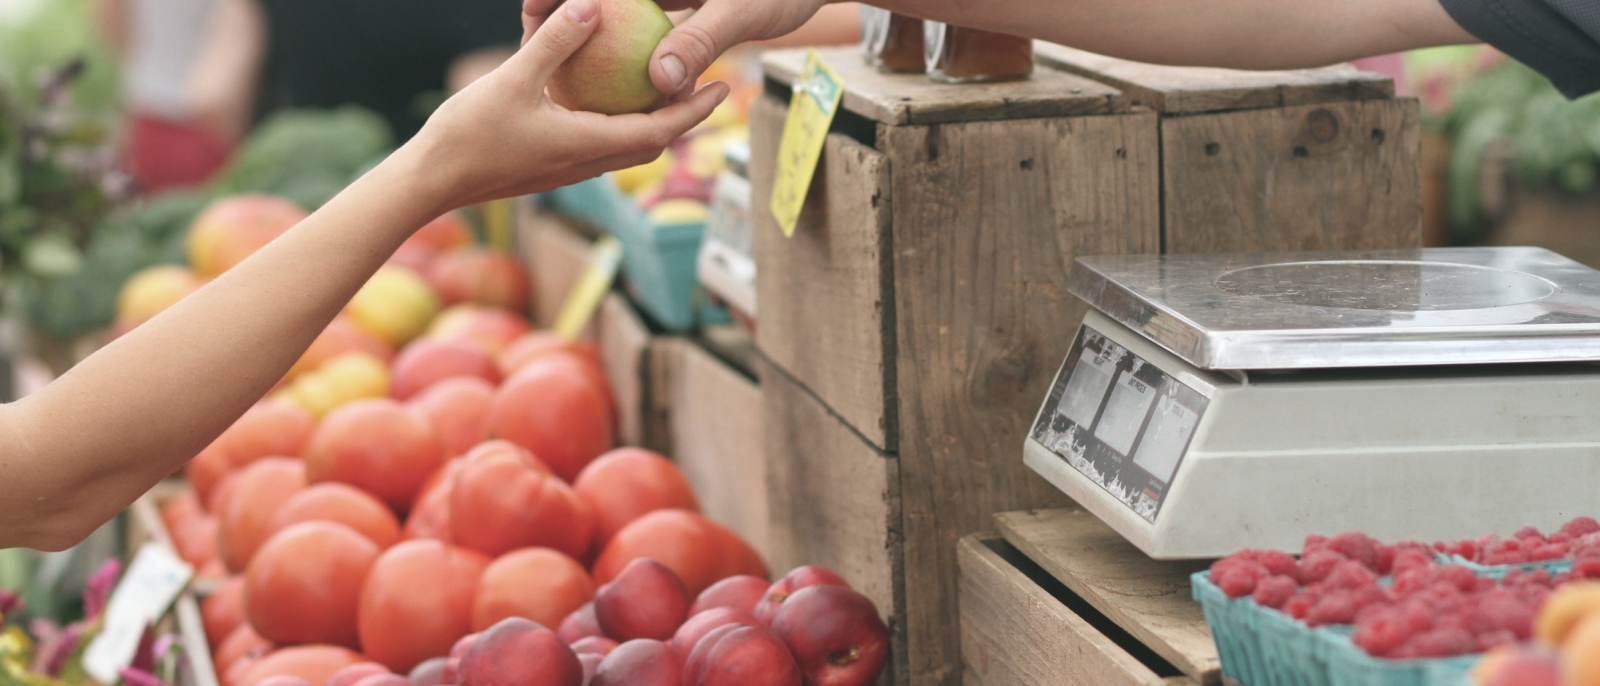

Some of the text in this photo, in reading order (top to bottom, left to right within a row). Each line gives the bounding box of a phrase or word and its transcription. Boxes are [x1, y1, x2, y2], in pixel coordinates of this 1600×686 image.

[1127, 377, 1136, 388] UNIT
[1133, 380, 1144, 392] PRICE
[1172, 404, 1181, 417] TOTAL
